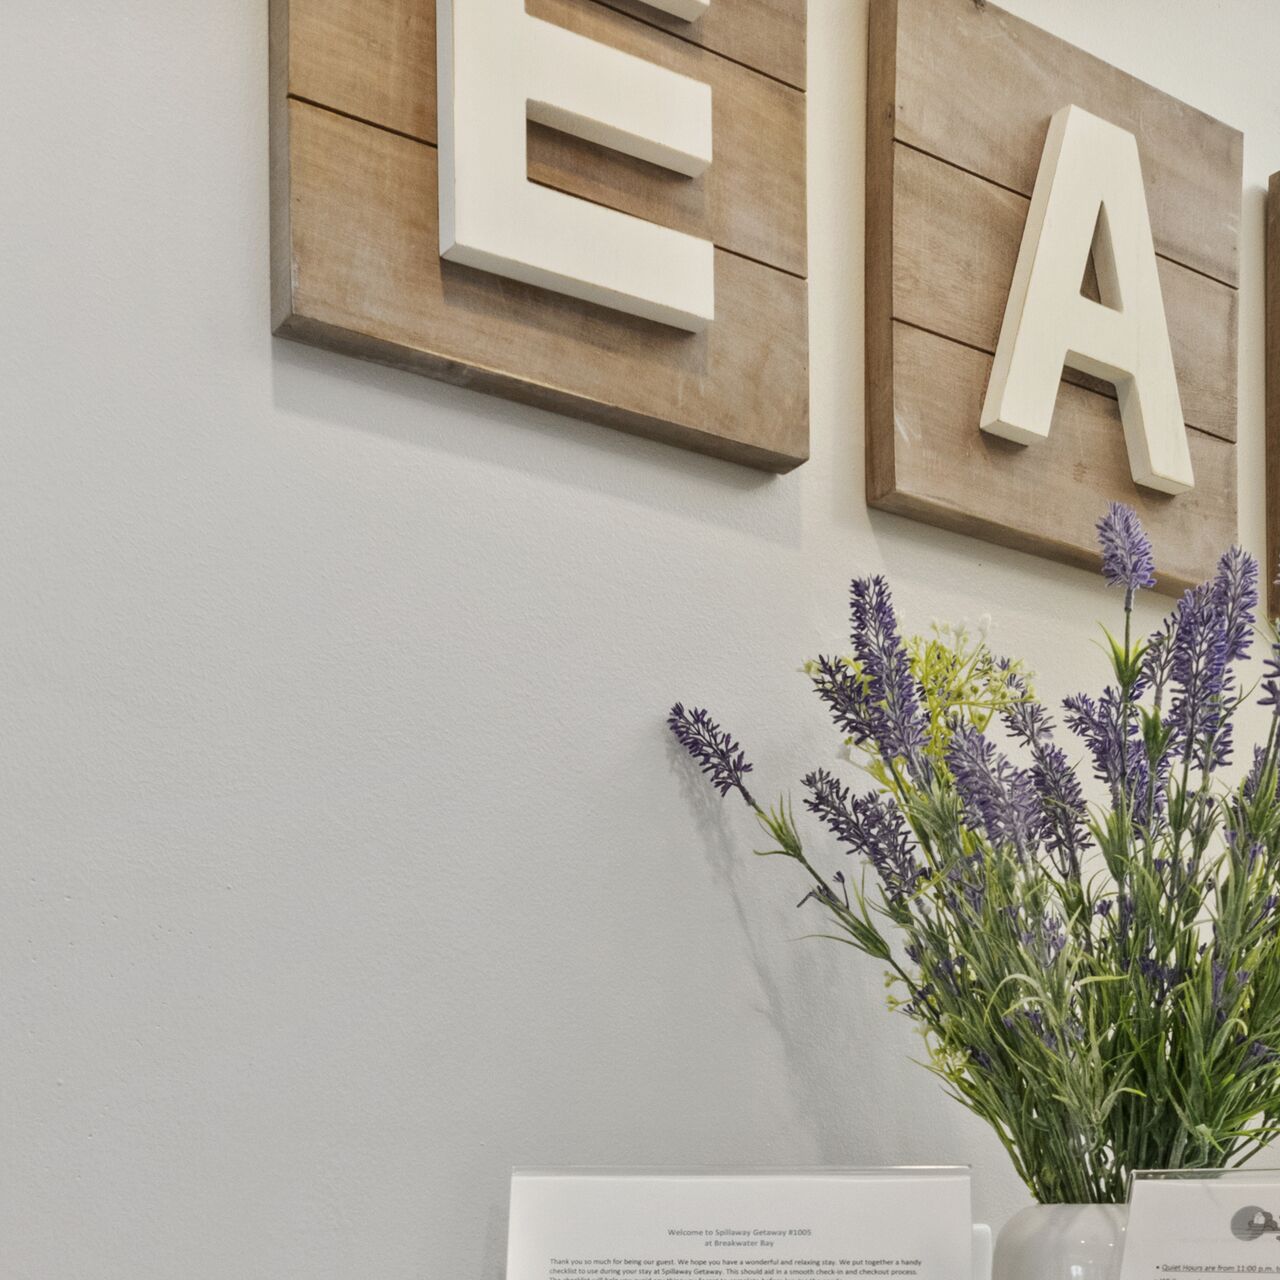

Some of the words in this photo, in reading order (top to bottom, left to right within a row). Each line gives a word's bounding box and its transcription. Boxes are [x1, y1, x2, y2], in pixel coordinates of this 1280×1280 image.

[667, 1228, 703, 1236] Welcome
[714, 1228, 750, 1237] Spillaway
[752, 1228, 787, 1237] Getaway
[787, 1228, 812, 1236] #1005
[759, 1239, 774, 1247] Bay
[1161, 1263, 1181, 1272] Quiet
[1181, 1264, 1203, 1273] Hours
[1216, 1264, 1235, 1273] from
[1235, 1264, 1257, 1273] 11:00
